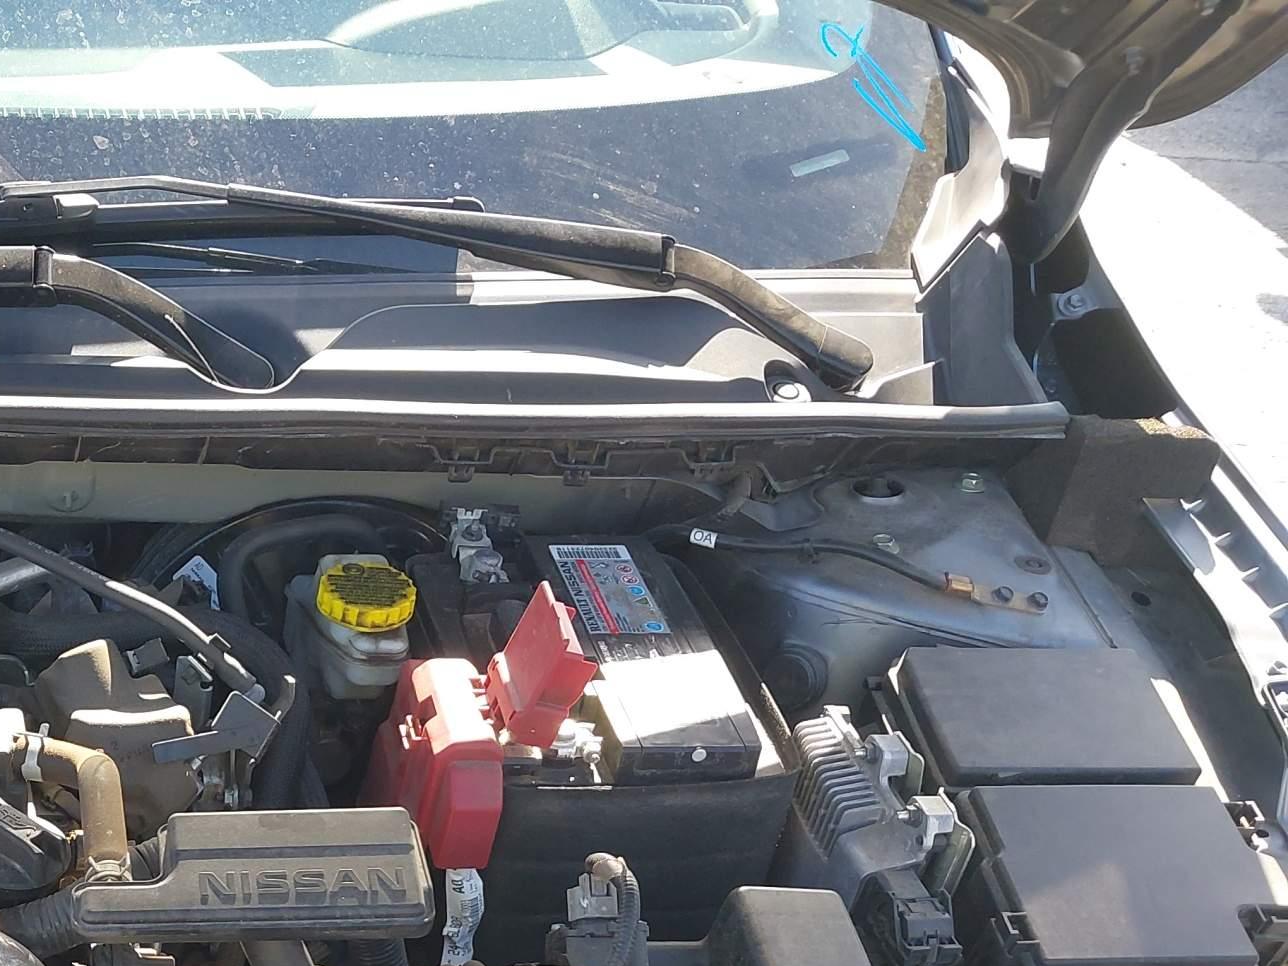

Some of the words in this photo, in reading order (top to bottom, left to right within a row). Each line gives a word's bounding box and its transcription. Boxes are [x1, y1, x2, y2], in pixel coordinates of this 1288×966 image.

[559, 560, 585, 599] NISSAN
[578, 598, 602, 633] RENAULT
[198, 866, 407, 906] NISSAN
